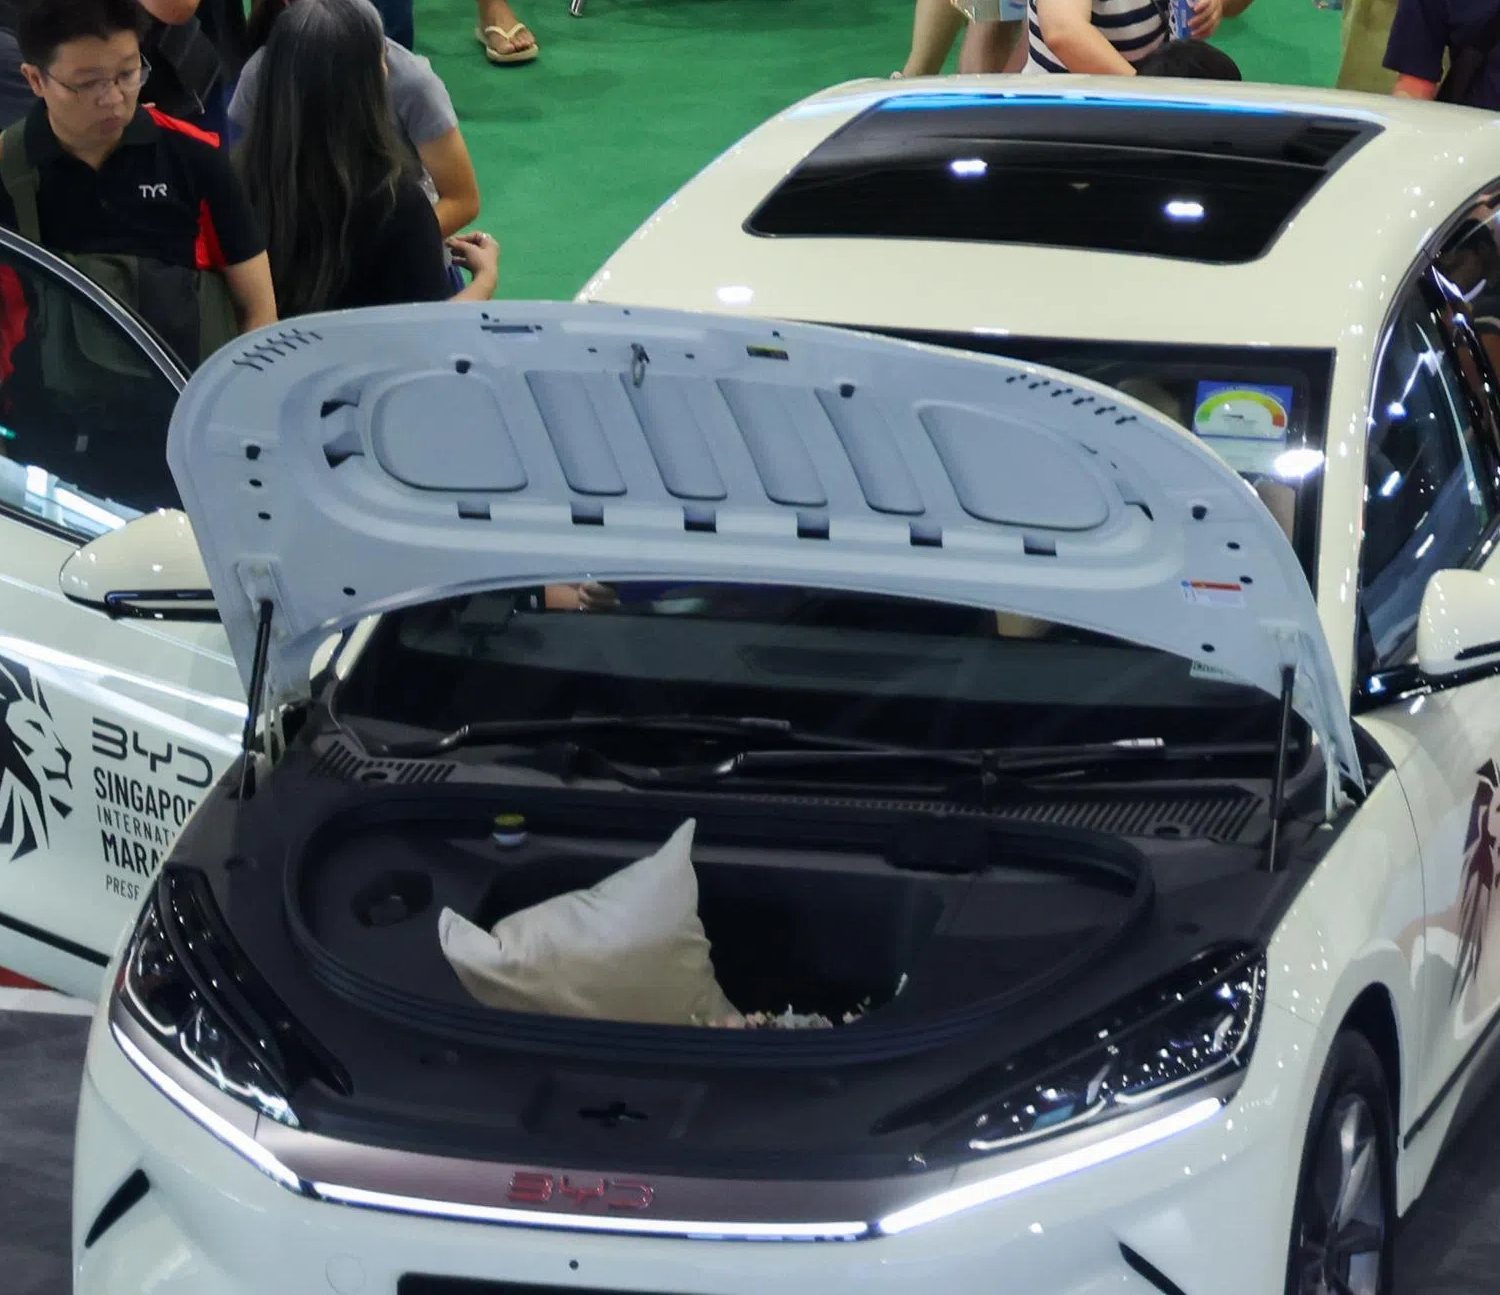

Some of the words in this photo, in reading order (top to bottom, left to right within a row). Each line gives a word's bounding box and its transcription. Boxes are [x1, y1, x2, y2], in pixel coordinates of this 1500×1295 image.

[138, 183, 168, 199] TYR
[92, 716, 213, 786] BYD
[508, 1171, 654, 1209] BYD
